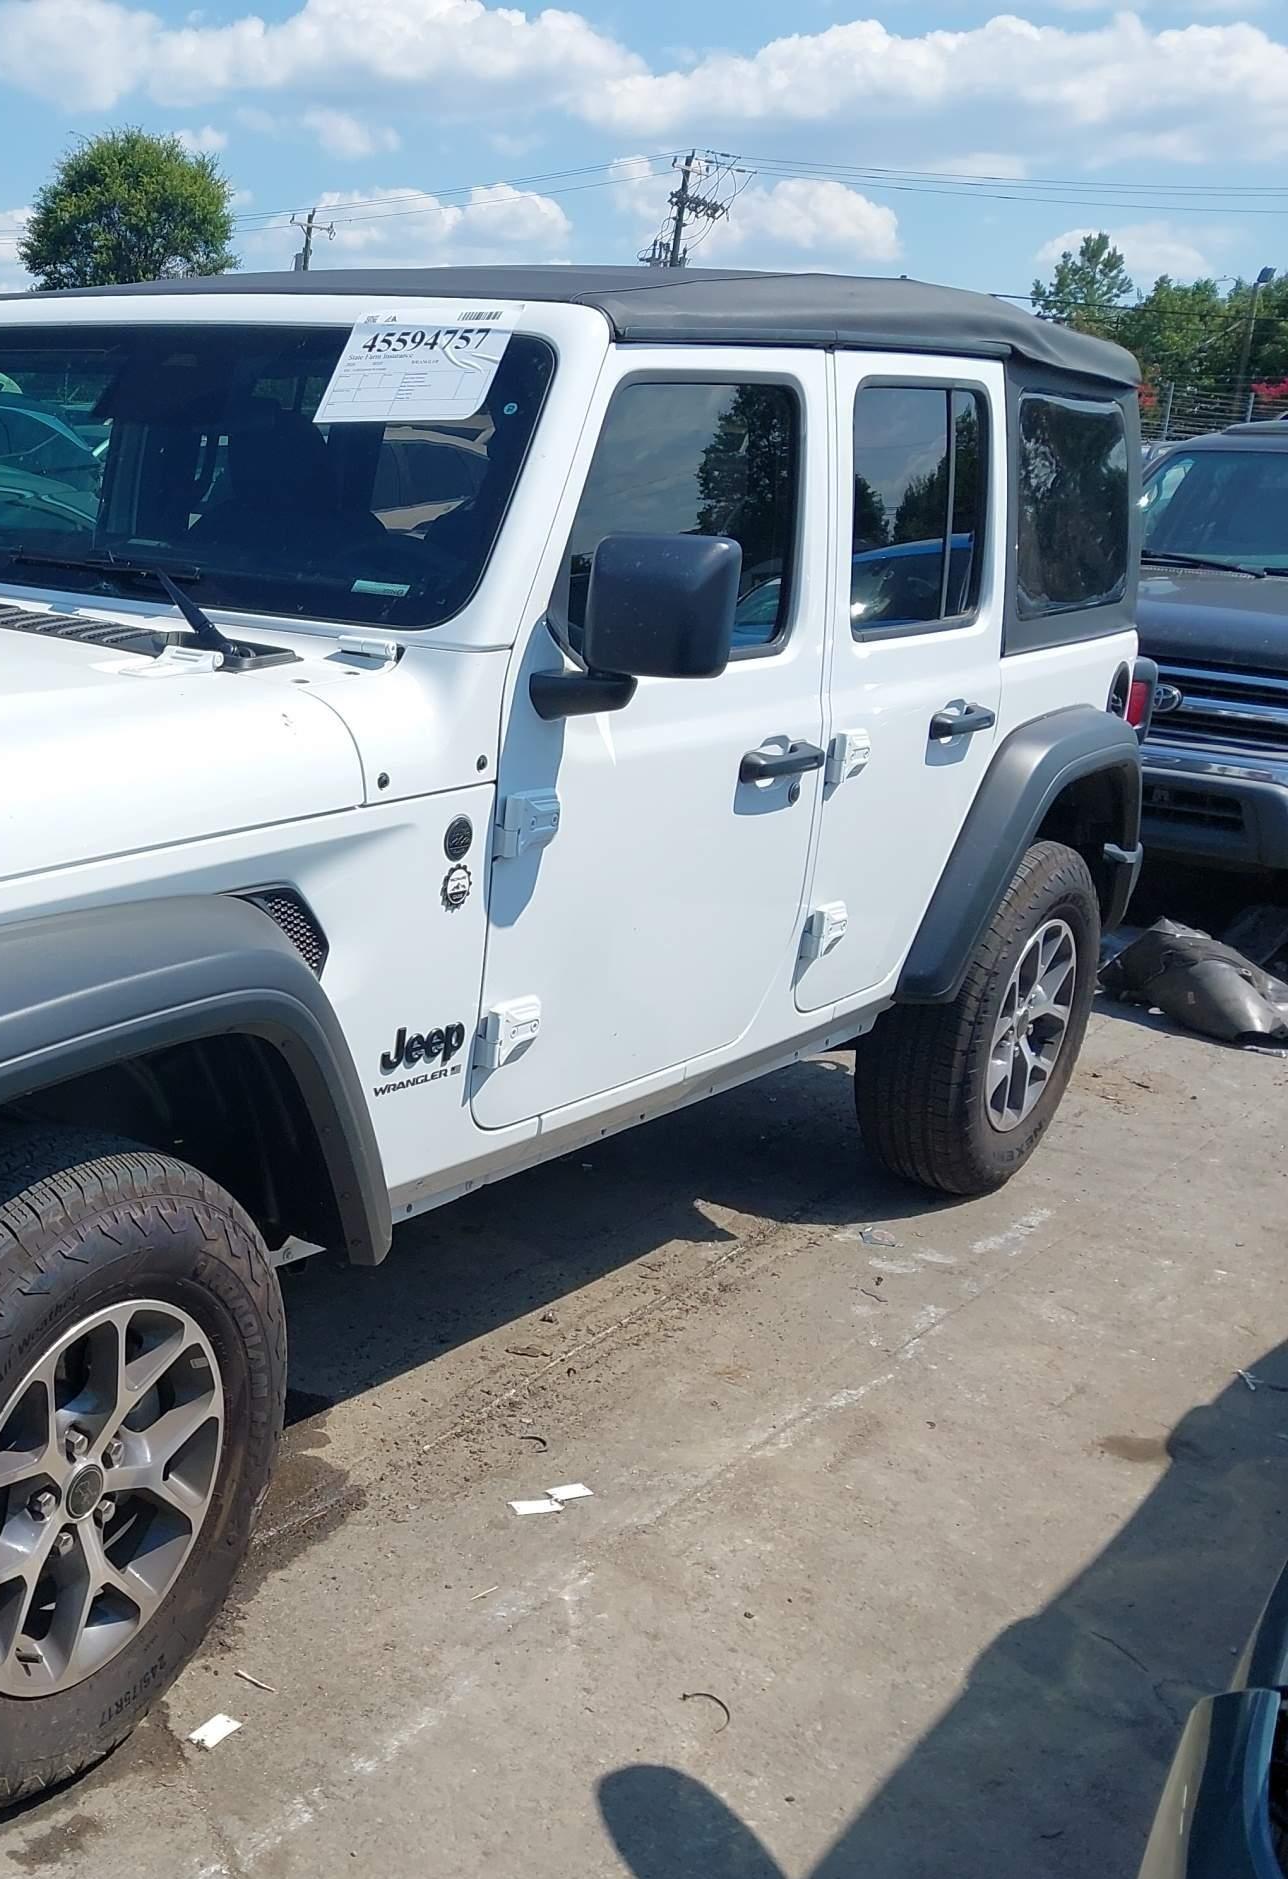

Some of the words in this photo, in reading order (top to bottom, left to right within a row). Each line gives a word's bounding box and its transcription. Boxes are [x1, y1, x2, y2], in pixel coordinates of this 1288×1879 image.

[362, 327, 492, 353] 45594757
[365, 353, 382, 361] Farm
[380, 1021, 465, 1071] Jeep
[373, 1068, 449, 1098] WRANGLER
[98, 1652, 167, 1729] 245/75R17
